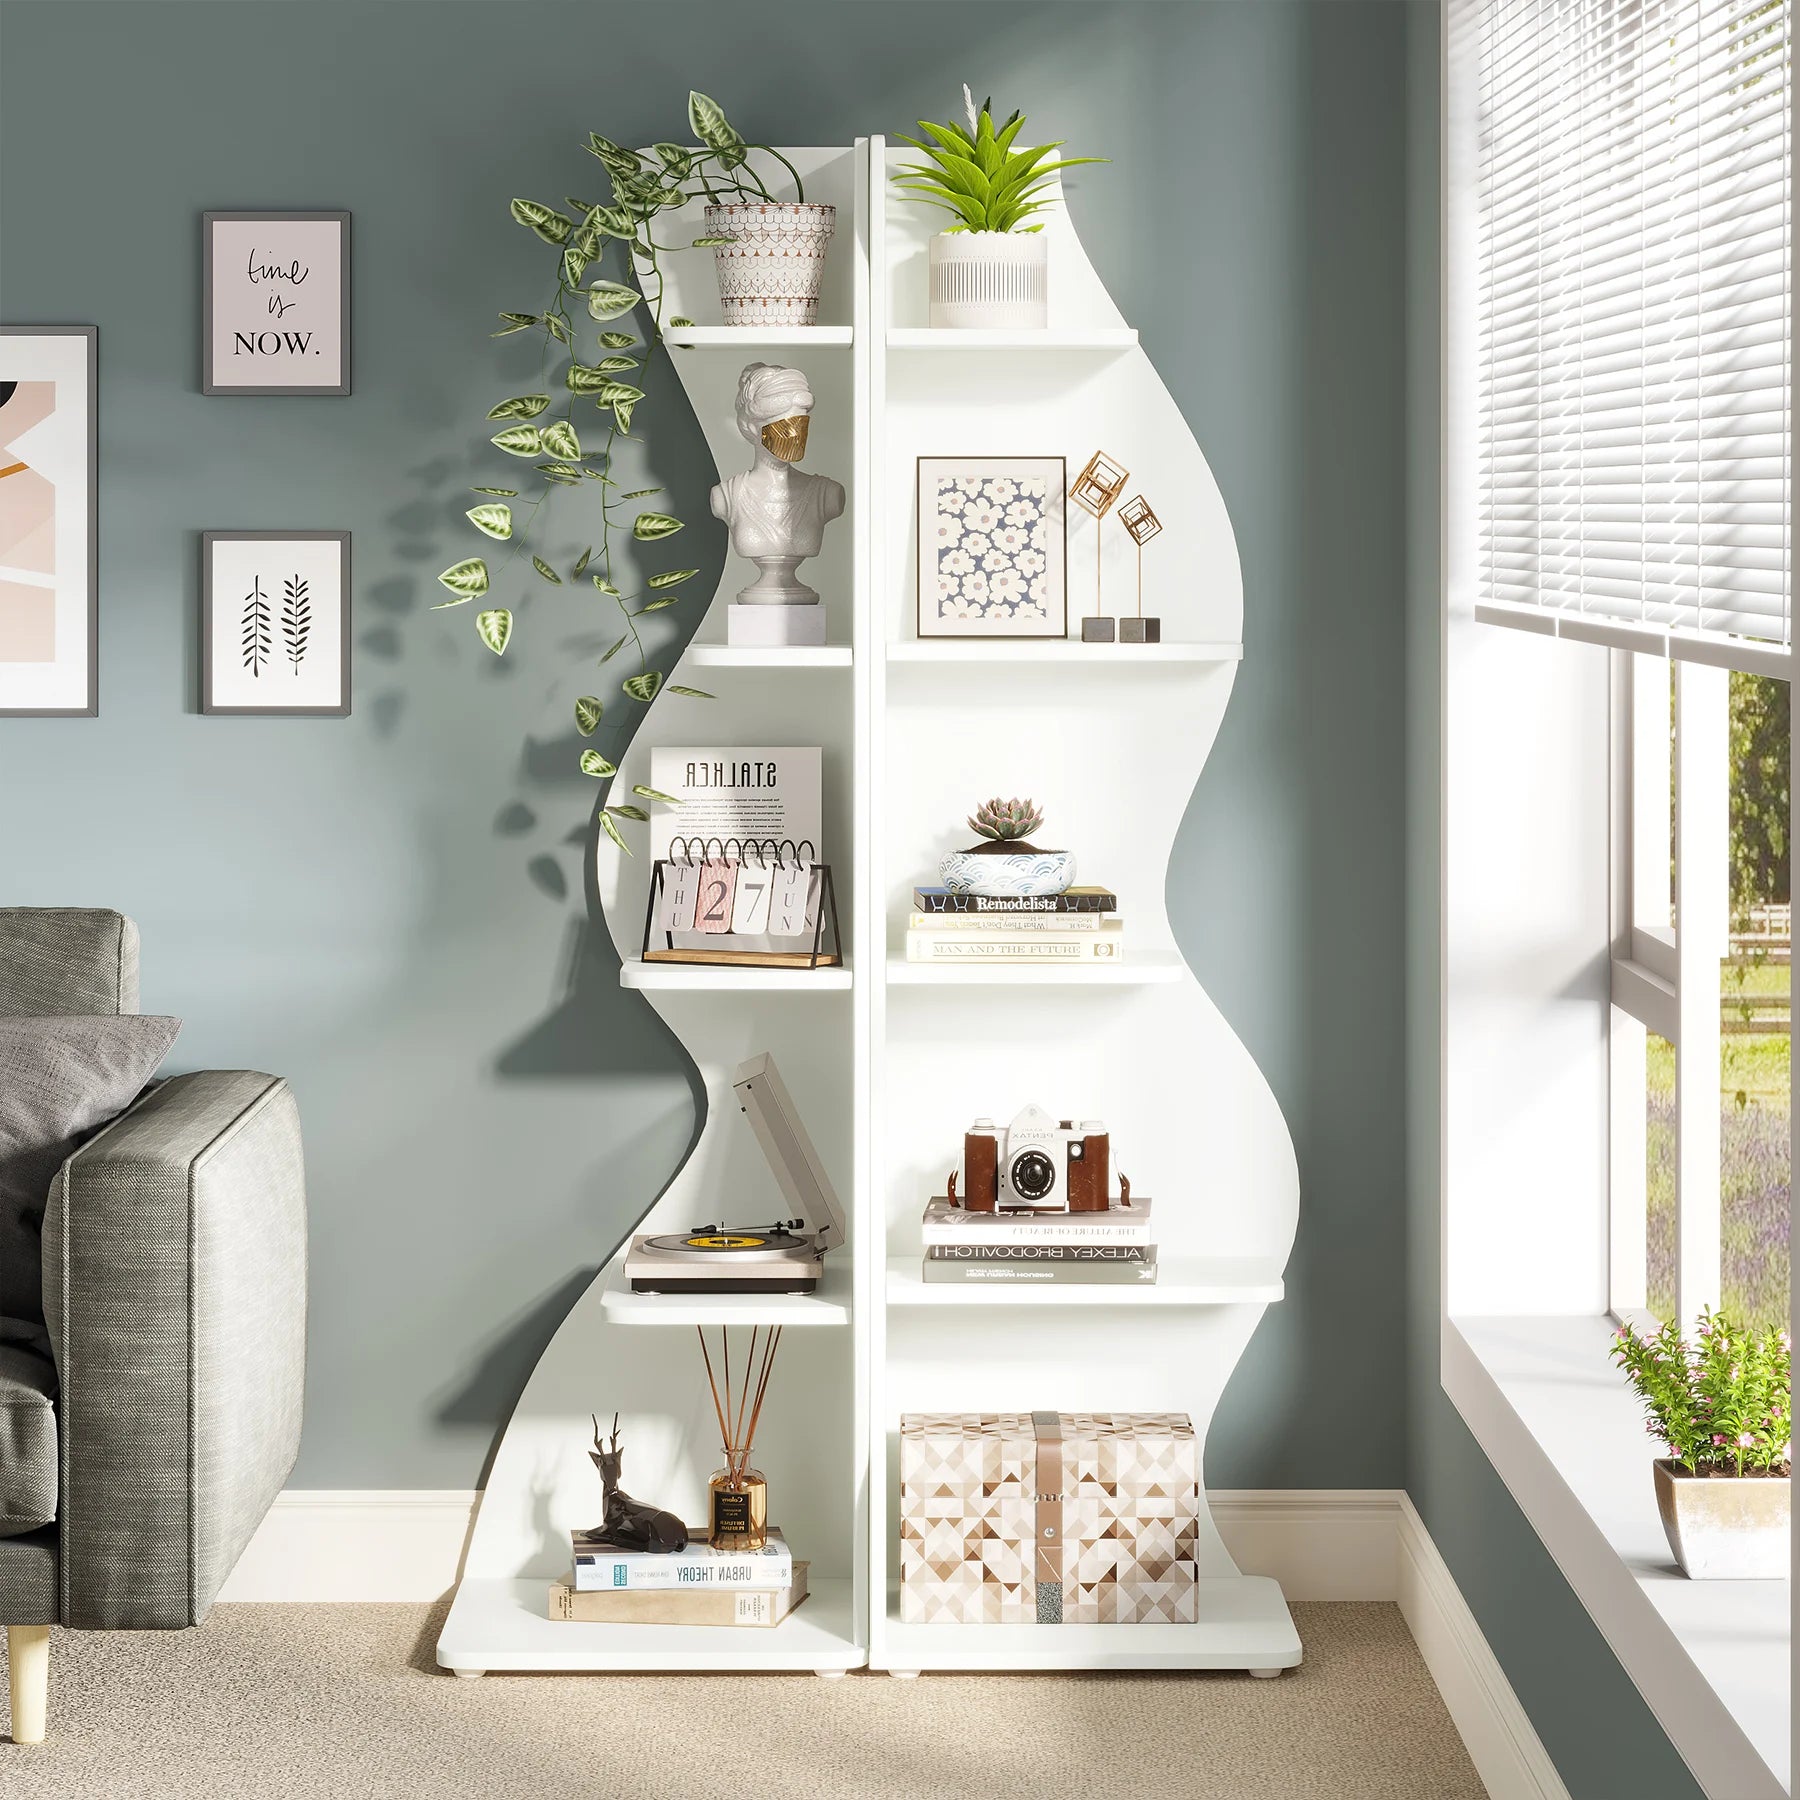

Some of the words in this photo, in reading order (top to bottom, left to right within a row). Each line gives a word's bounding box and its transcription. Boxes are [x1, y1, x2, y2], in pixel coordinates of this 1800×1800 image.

[247, 248, 309, 285] time
[268, 288, 297, 319] is
[233, 331, 320, 356] NOW.
[671, 867, 688, 928] THU
[781, 870, 798, 931] JUN
[976, 895, 1058, 911] Remodelista
[1003, 921, 1022, 930] They
[1023, 922, 1046, 930] What
[933, 945, 963, 954] MAN
[967, 945, 995, 954] AND
[998, 945, 1026, 954] THE
[1029, 945, 1081, 954] FUTURE
